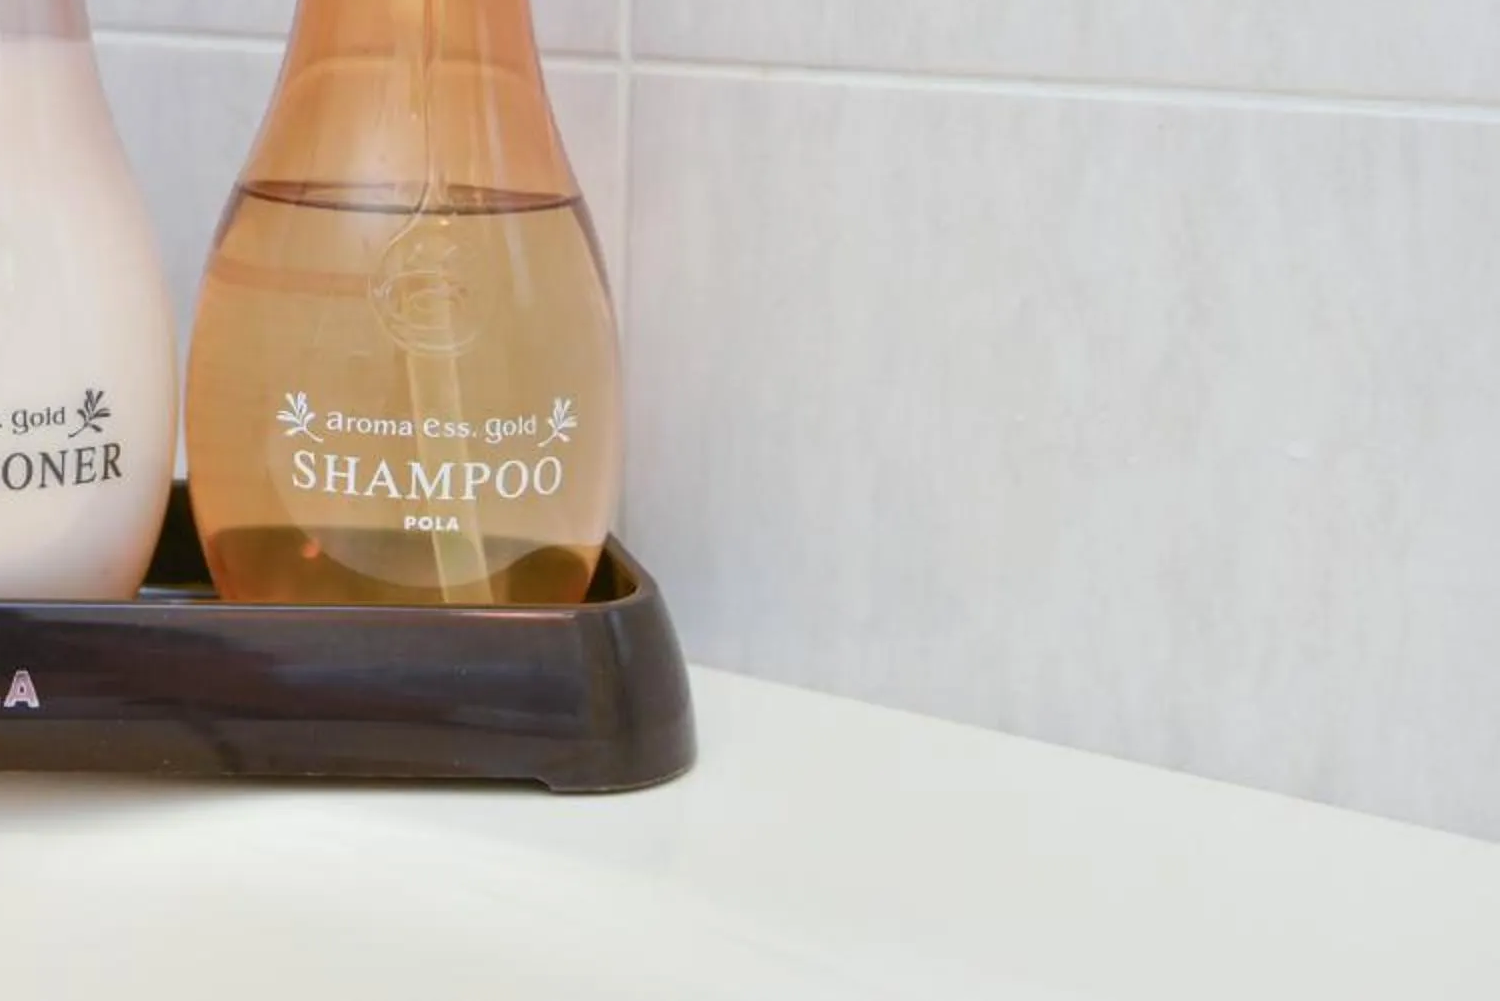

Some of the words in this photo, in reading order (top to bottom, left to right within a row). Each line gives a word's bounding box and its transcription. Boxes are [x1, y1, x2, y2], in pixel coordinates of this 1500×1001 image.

[11, 405, 66, 435] gold
[326, 410, 413, 436] aroma
[422, 415, 477, 439] ess.
[484, 414, 537, 444] gold
[291, 449, 564, 501] SHAMPOO
[404, 515, 460, 532] POLA
